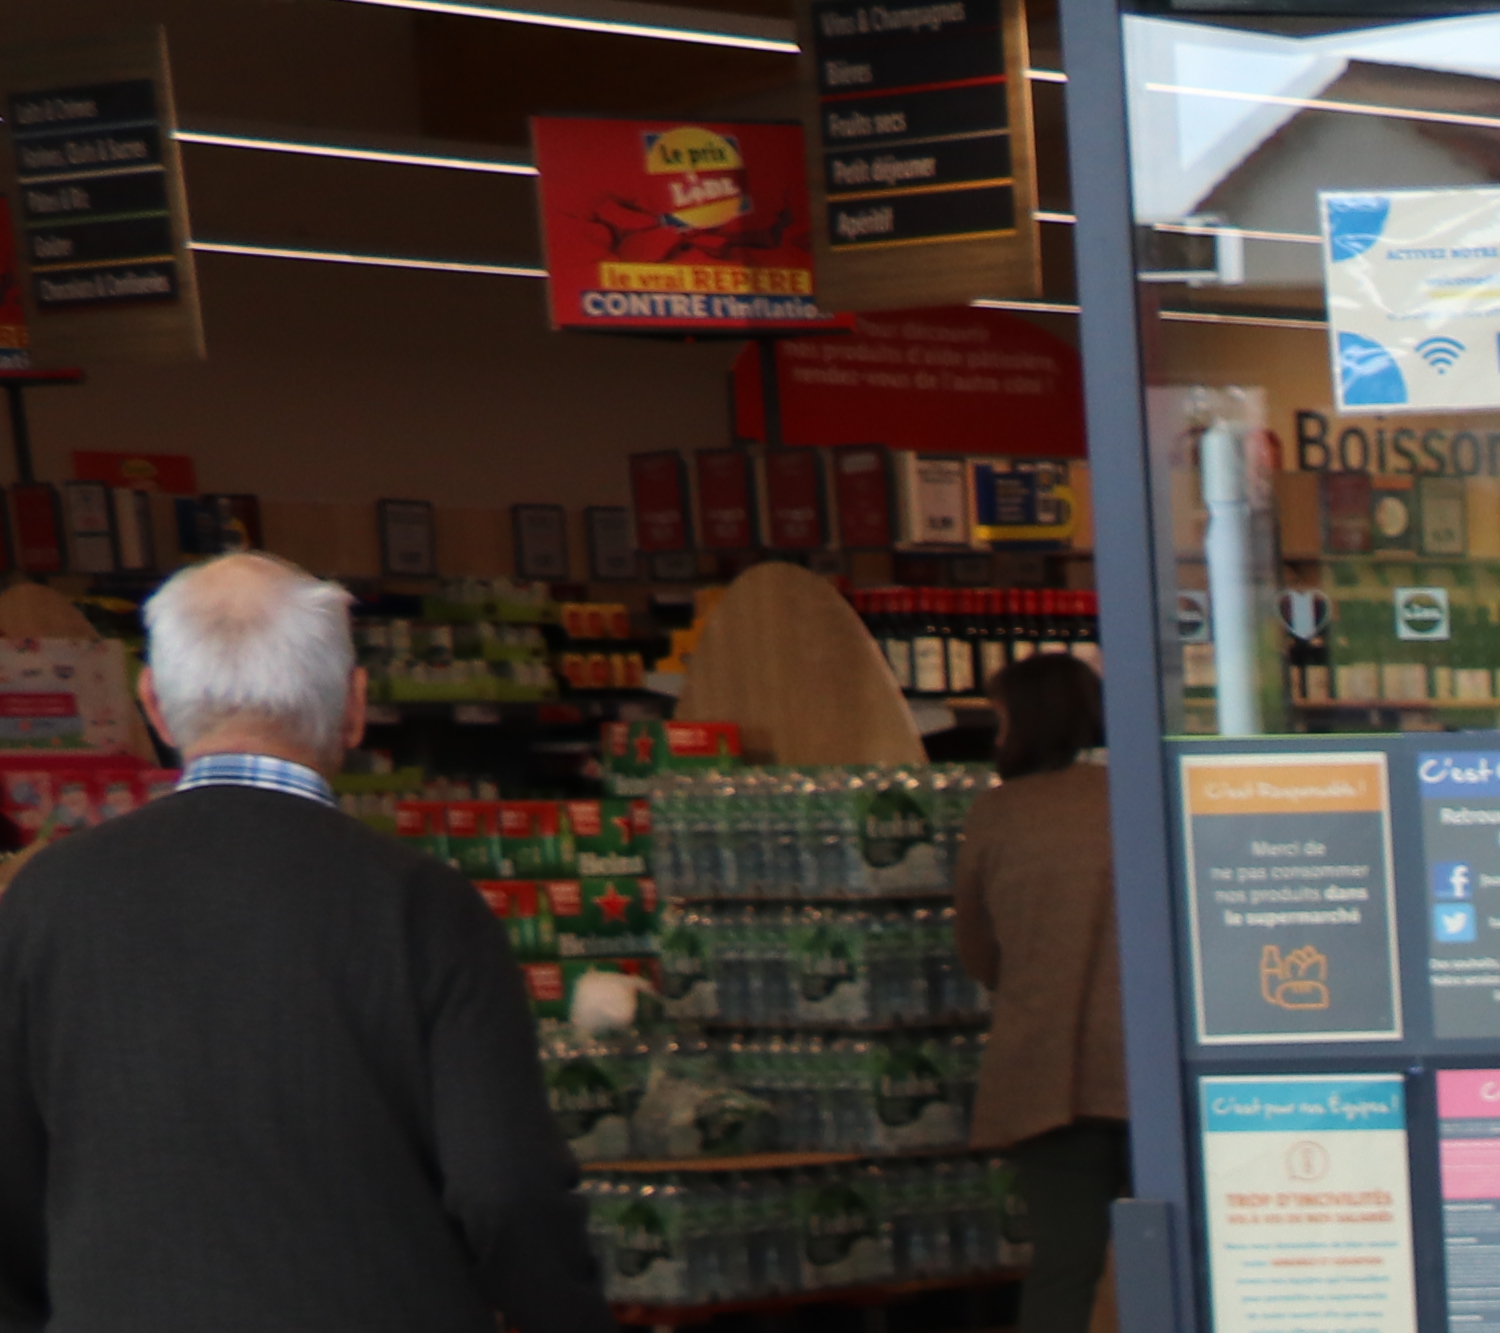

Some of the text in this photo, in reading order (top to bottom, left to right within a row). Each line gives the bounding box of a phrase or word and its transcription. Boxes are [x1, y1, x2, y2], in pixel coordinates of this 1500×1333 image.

[659, 145, 727, 168] Le prix
[580, 293, 834, 320] CONTRE l'inflatio
[1419, 758, 1493, 783] C'est
